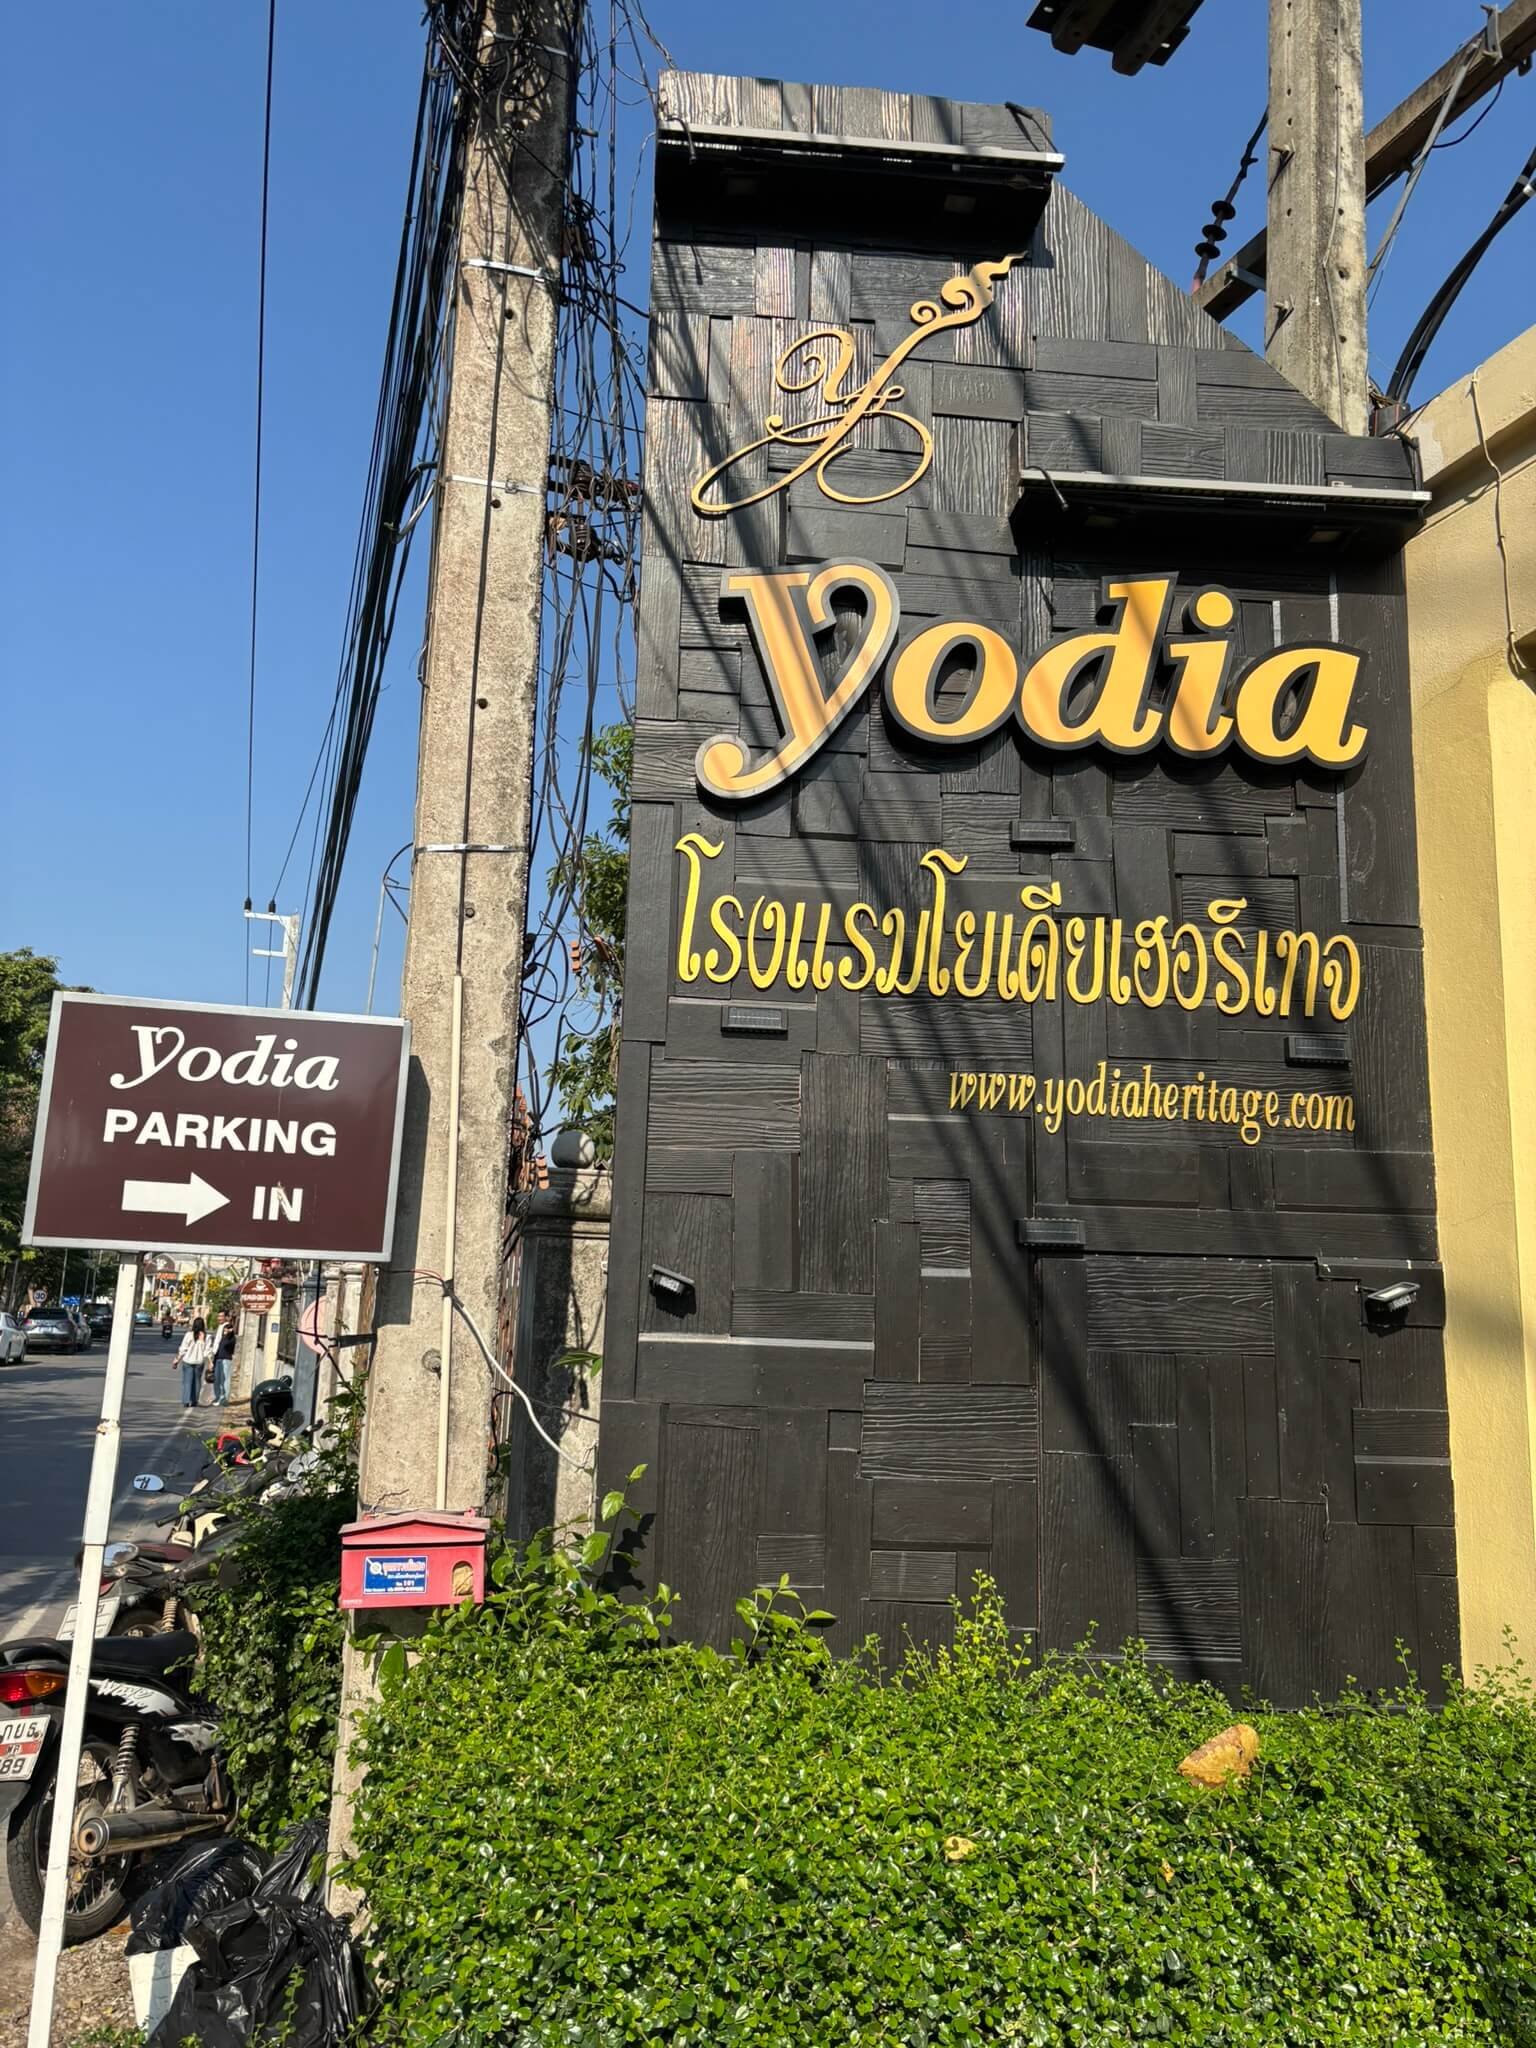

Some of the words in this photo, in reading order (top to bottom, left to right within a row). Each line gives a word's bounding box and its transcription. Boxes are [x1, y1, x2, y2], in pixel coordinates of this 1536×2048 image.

[675, 832, 1362, 1022] โรงแรมโยเดียเฮอริเทจ
[948, 1062, 1357, 1145] www.yodiaheritage.com
[103, 1108, 337, 1157] PARKING
[252, 1185, 304, 1223] IN
[0, 1757, 26, 1775] 89
